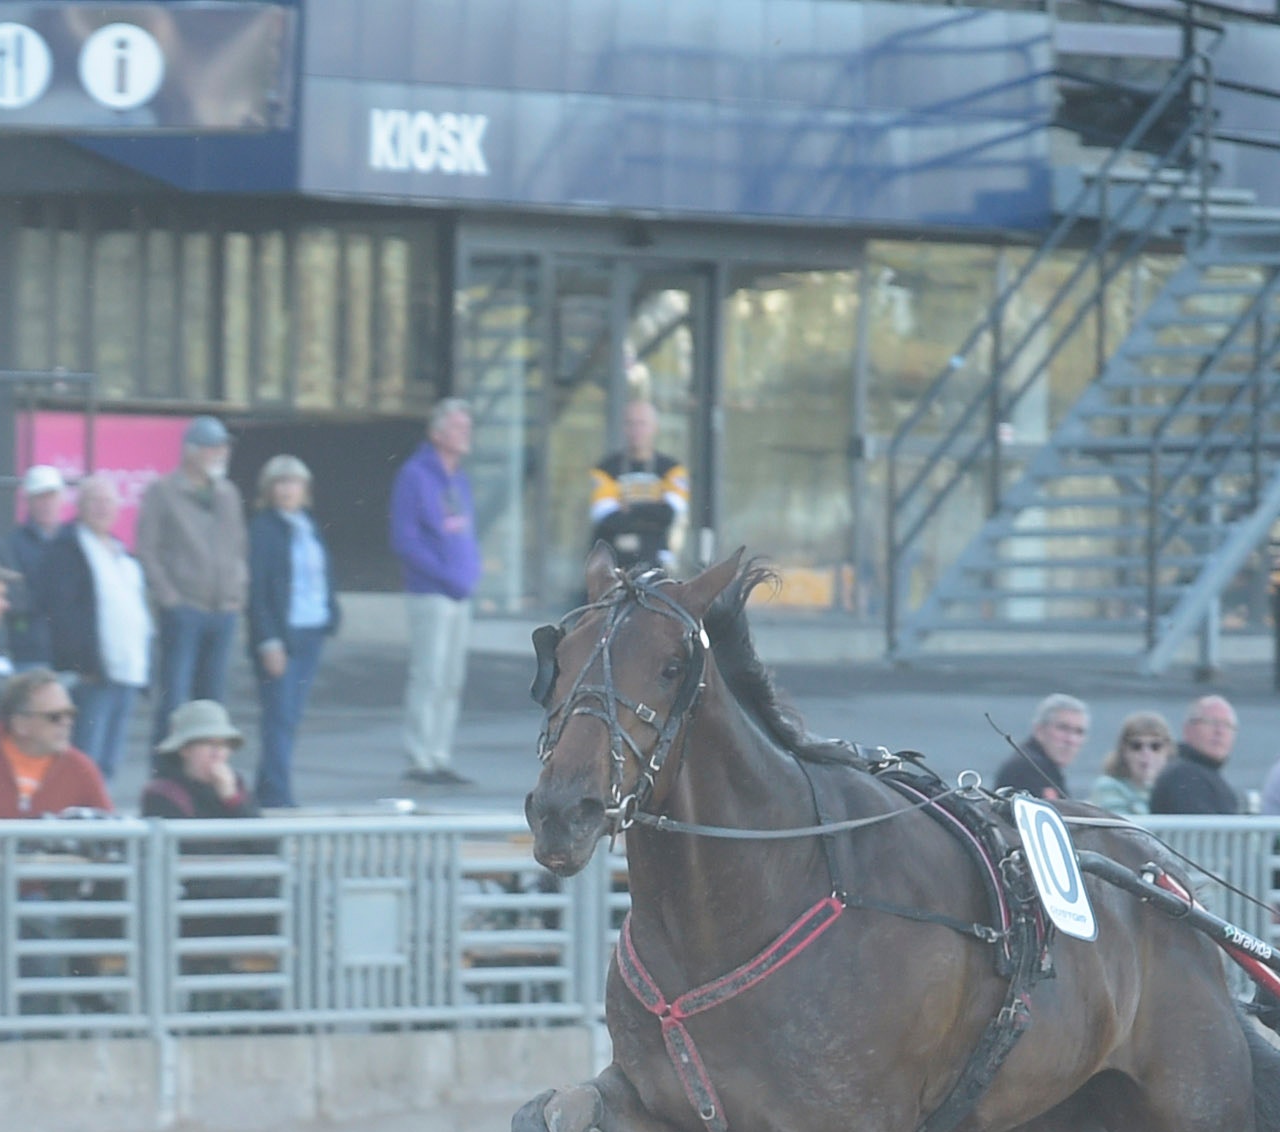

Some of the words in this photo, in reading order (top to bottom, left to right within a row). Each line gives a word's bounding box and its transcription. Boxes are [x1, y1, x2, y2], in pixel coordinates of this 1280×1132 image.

[369, 108, 490, 176] KIOSK
[1019, 804, 1079, 904] 10
[1231, 927, 1272, 959] bravida
